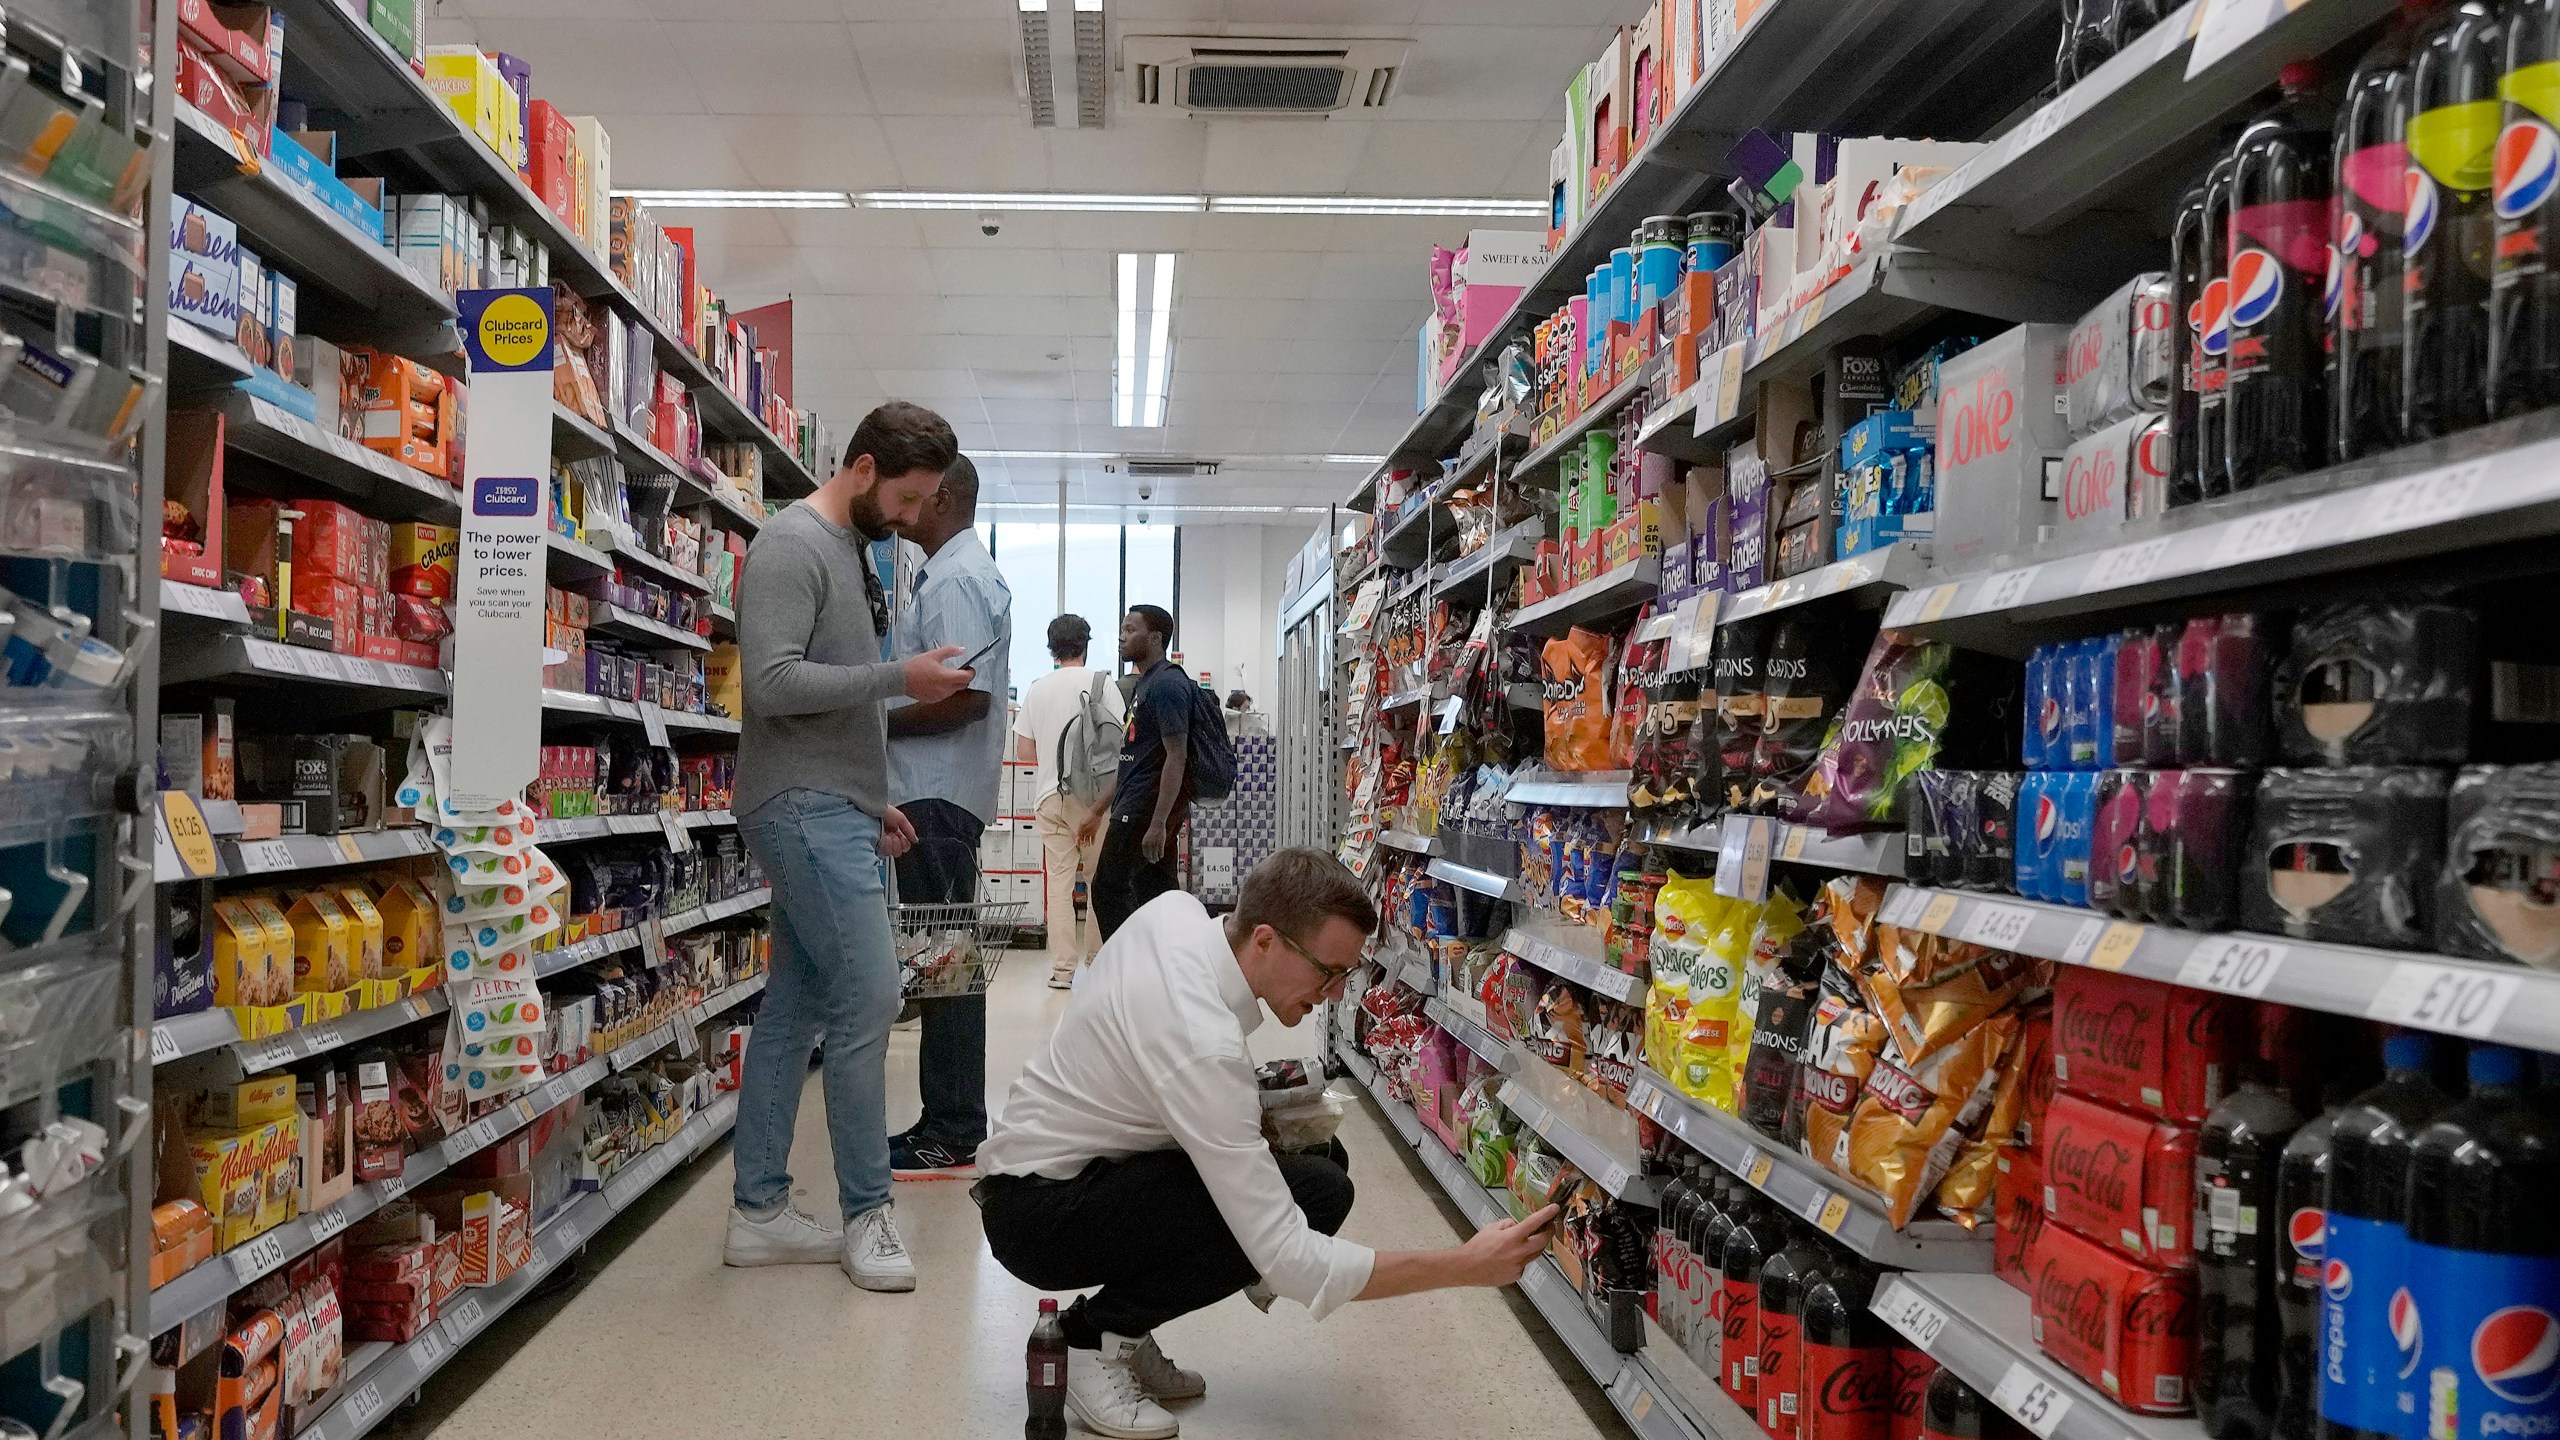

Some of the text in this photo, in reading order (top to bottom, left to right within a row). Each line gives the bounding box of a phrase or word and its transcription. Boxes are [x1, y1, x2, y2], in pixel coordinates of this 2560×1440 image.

[427, 78, 471, 93] MAKERS
[1482, 254, 1519, 265] SWEET
[1522, 255, 1529, 264] &
[484, 320, 543, 331] Clubcard
[494, 333, 533, 345] Prices
[2068, 323, 2105, 384] Coke
[1937, 377, 2014, 472] Coke
[2065, 451, 2115, 520] Coke
[485, 494, 527, 504] Clubcard
[467, 531, 541, 546] The power
[1647, 525, 1658, 533] SA
[474, 548, 532, 560] to lower
[480, 564, 527, 579] prices.
[477, 587, 525, 596] Save when
[1993, 573, 2027, 603] £5
[469, 599, 532, 609] you scan your
[478, 609, 522, 619] Clubcard.
[265, 645, 295, 669] £1.15
[174, 816, 201, 837] £1.25
[1979, 911, 2027, 941] £4.65
[2208, 942, 2269, 990] £10
[2412, 976, 2500, 1028] £10
[1697, 1028, 1720, 1038] HEESE
[318, 1209, 345, 1236] £1.15
[251, 1237, 282, 1271] £1.15
[312, 1299, 341, 1334] nutella
[1902, 1302, 1939, 1341] £4.70
[285, 1317, 312, 1354] nutella
[2327, 1301, 2347, 1384] pepsi
[354, 1385, 381, 1417] £1.15
[2017, 1385, 2052, 1422] £5
